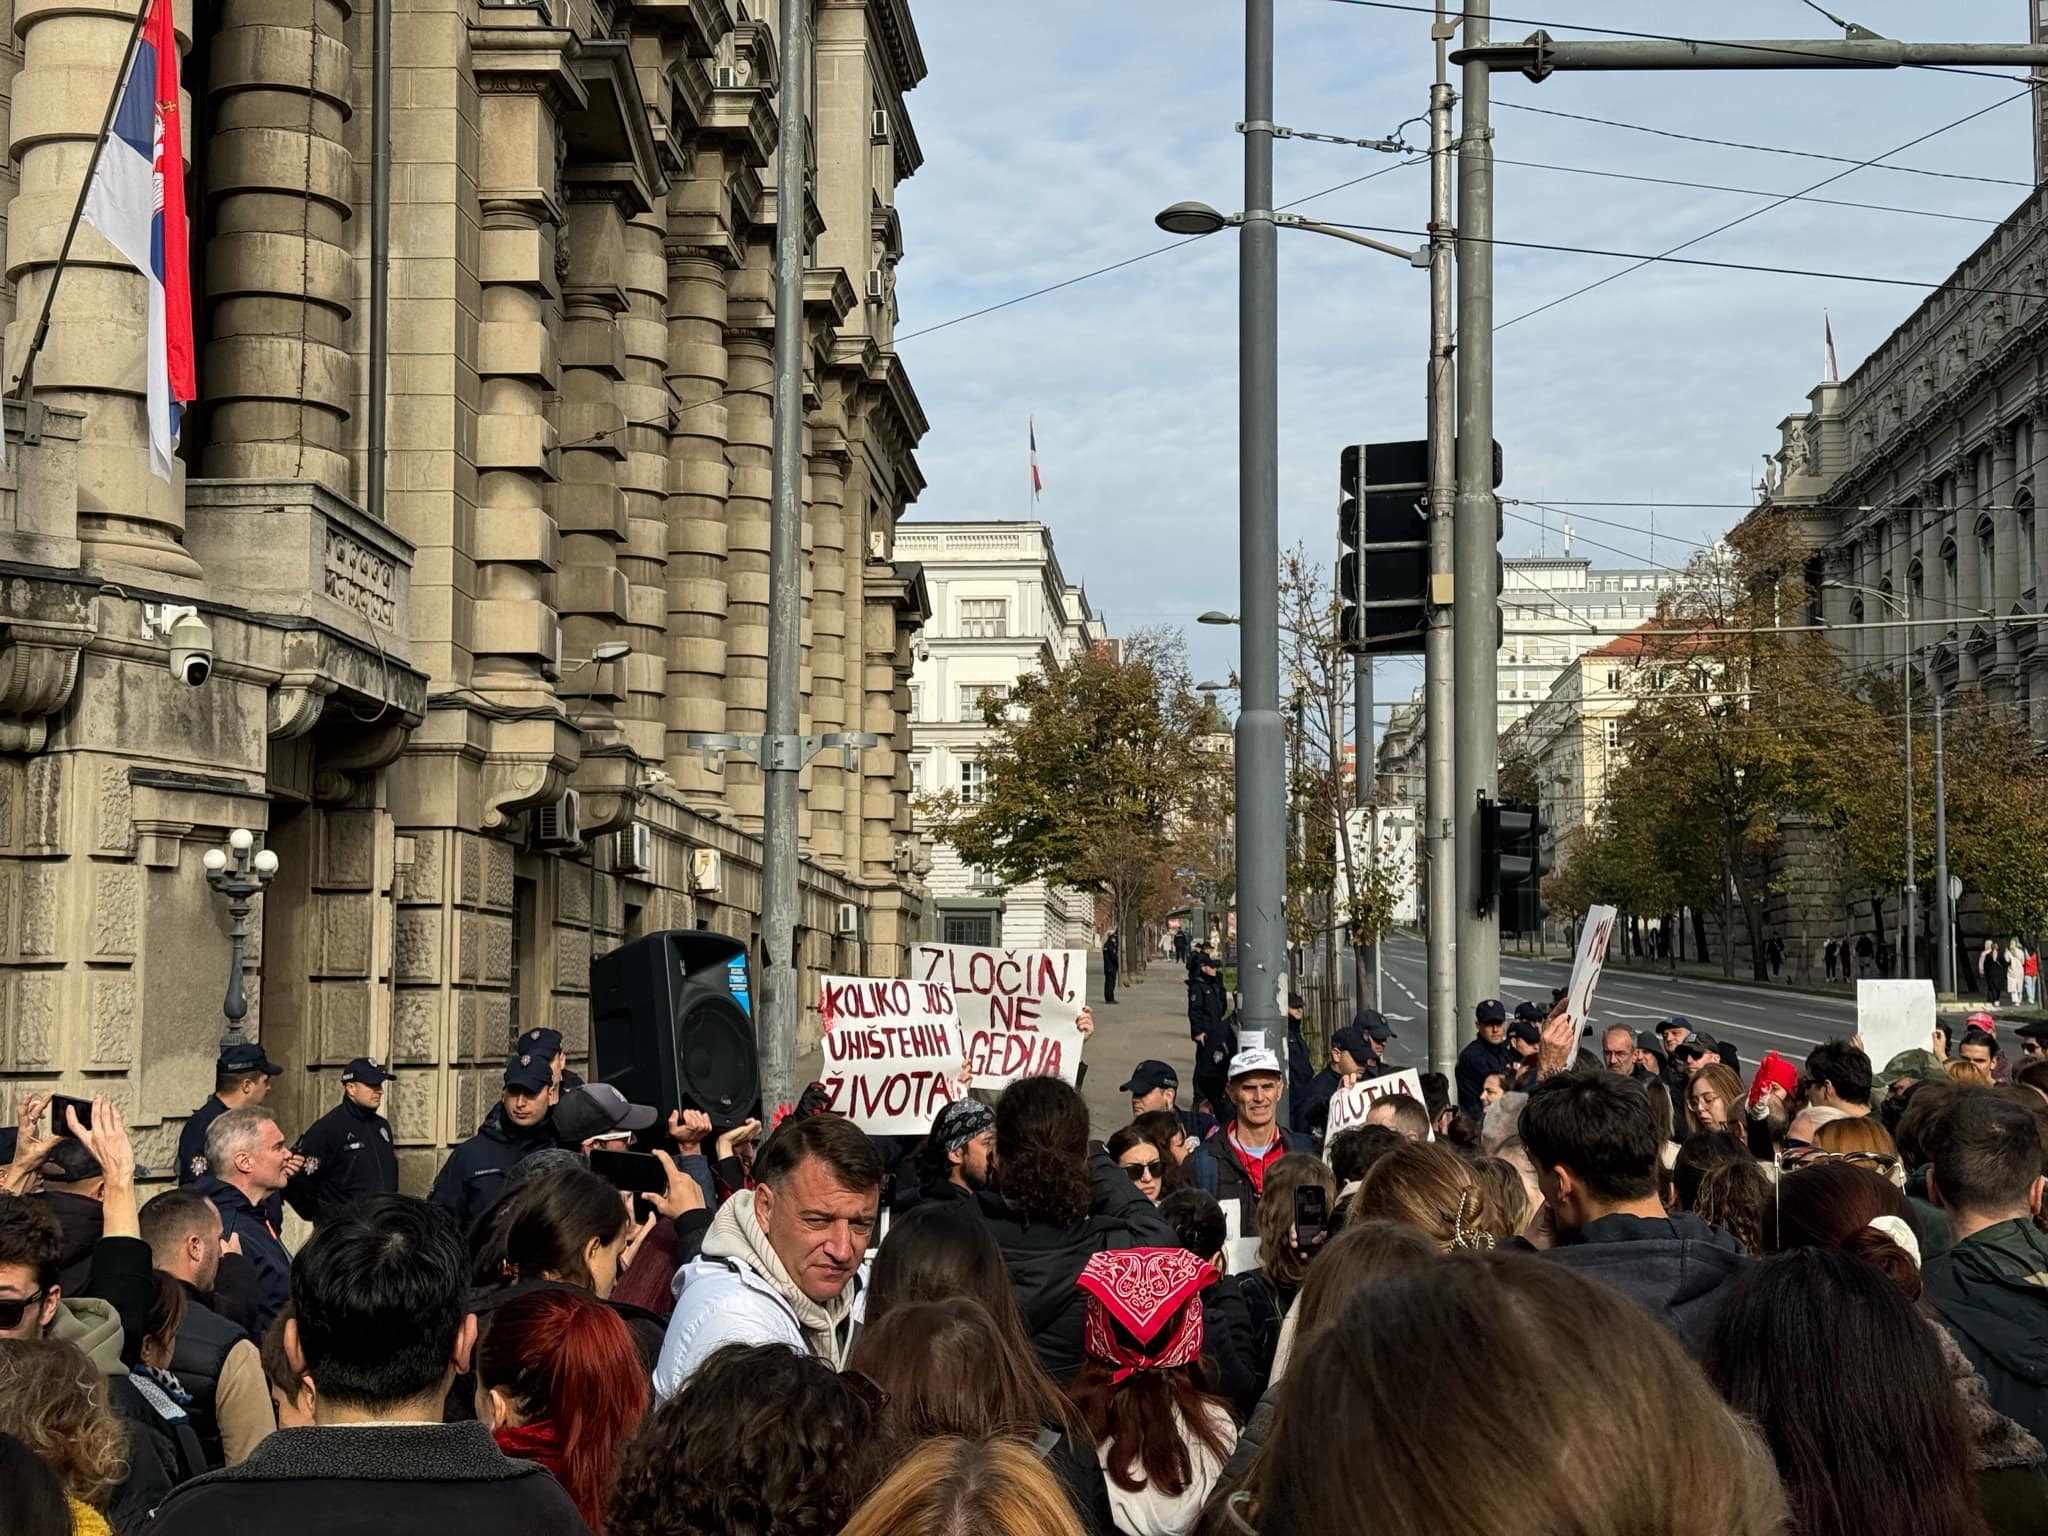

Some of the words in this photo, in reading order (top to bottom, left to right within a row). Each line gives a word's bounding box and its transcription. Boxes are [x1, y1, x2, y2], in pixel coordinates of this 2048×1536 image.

[919, 947, 1075, 1003] ZLOČIN,
[825, 979, 910, 1018] KOLIKO
[918, 982, 953, 1015] JOŠ
[990, 995, 1041, 1032] NE
[827, 1024, 951, 1061] UNIŠTENIH
[959, 1030, 1062, 1078] GEDIJA
[825, 1070, 953, 1119] ŽIVOTA
